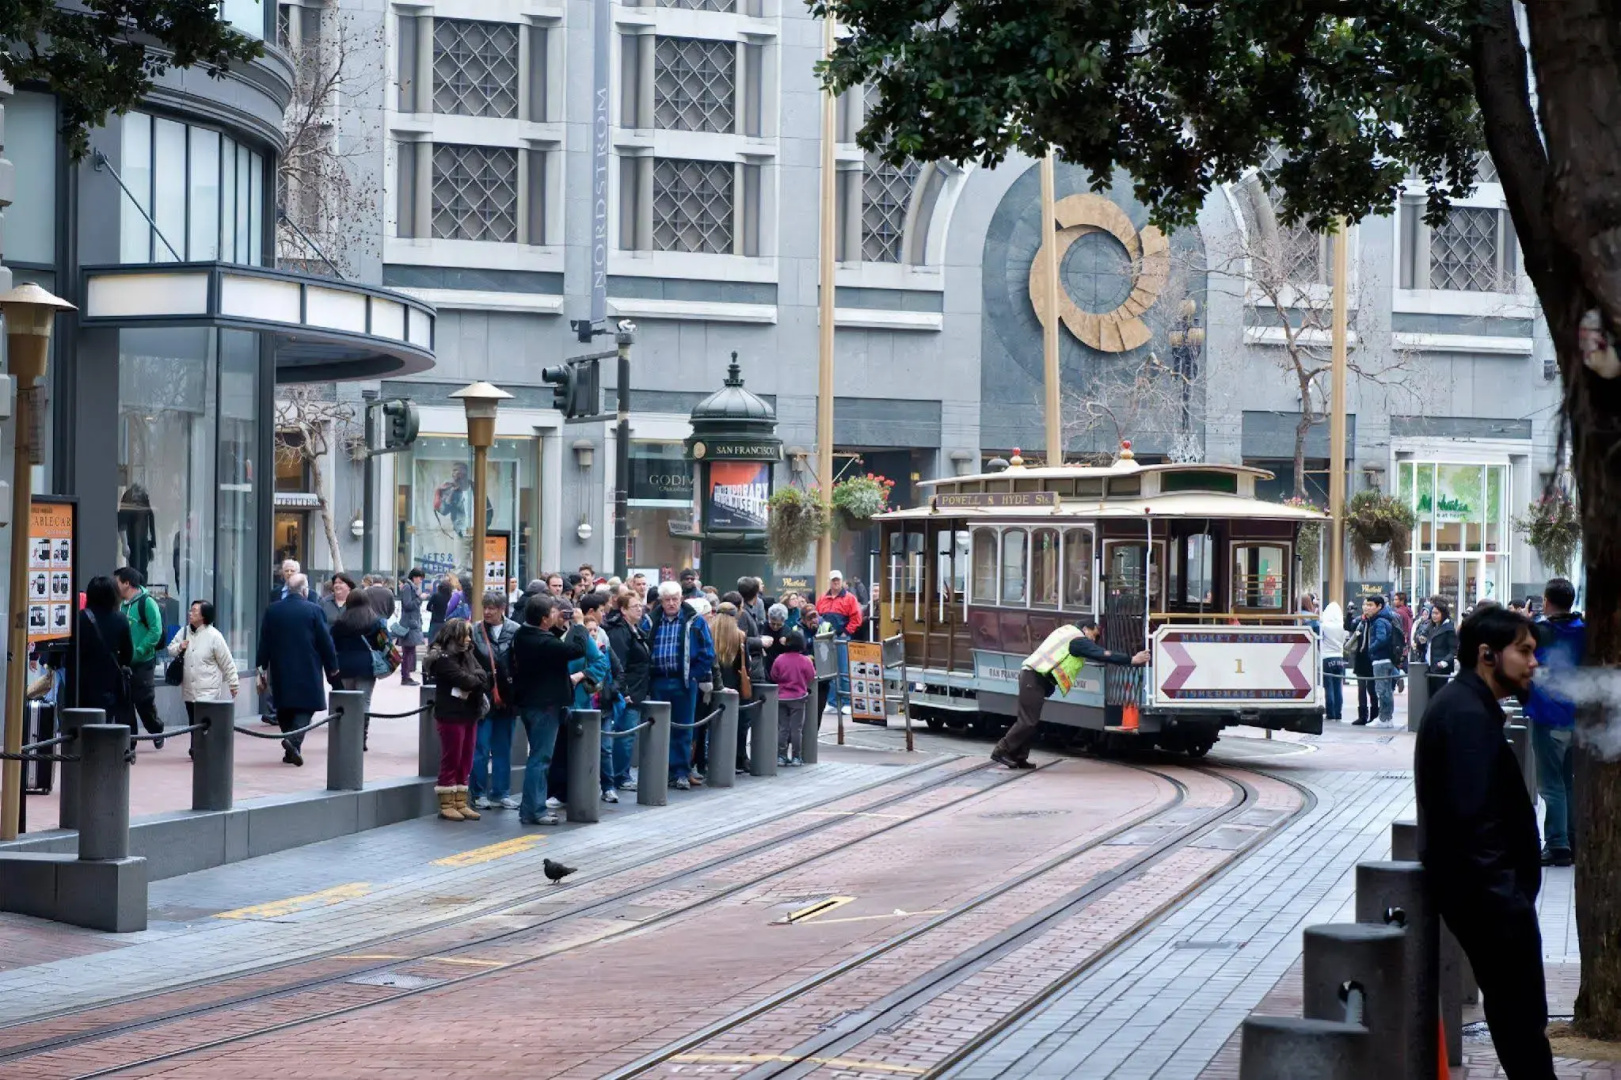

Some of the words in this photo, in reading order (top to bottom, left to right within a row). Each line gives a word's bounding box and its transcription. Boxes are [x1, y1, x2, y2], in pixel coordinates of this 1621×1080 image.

[594, 88, 607, 289] NORDSTROM
[716, 446, 733, 455] SAN
[734, 445, 775, 456] FRANCISCO
[649, 474, 695, 486] GODIV
[941, 496, 981, 505] POWELL
[987, 496, 994, 505] &
[1002, 495, 1029, 505] HYDE
[1181, 633, 1232, 643] MARKET
[1235, 659, 1245, 673] 1
[1001, 670, 1020, 680] FRANC
